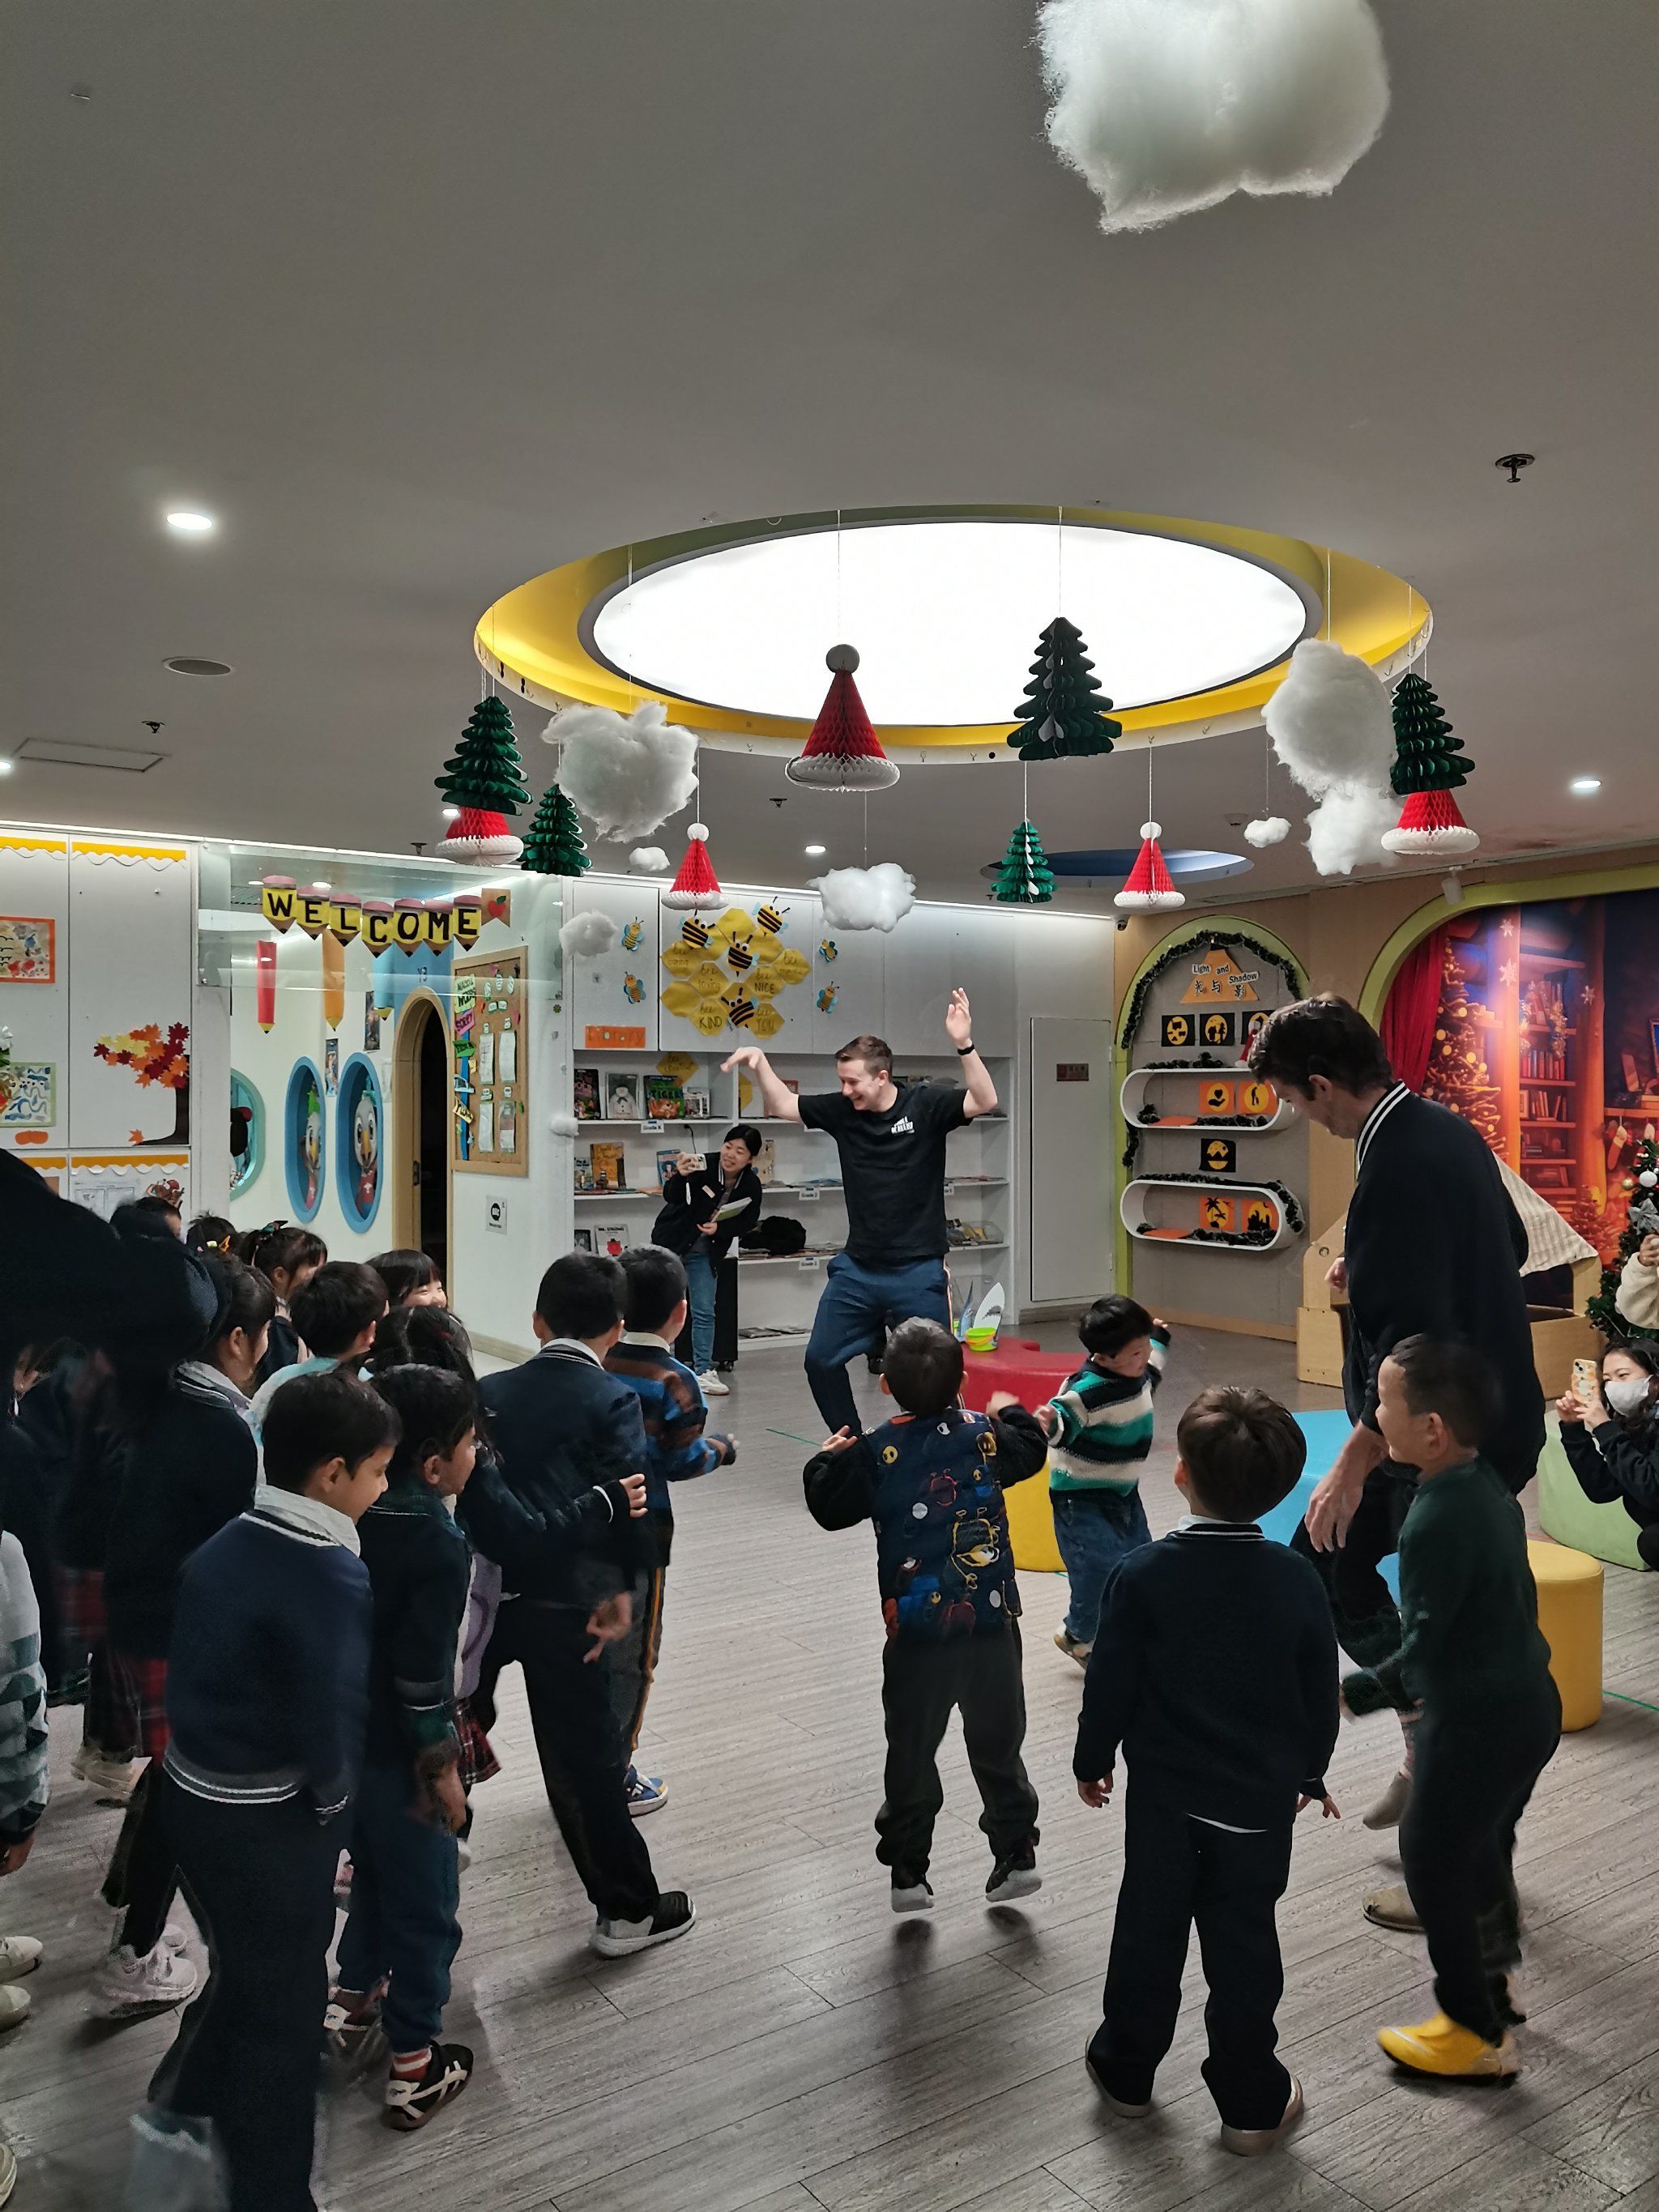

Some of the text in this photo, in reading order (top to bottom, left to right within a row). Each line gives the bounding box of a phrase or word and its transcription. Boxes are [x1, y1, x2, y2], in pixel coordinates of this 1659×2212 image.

[267, 893, 478, 943] WELCOME
[1193, 964, 1257, 984] Light and Shadow
[754, 982, 775, 995] NICE
[699, 1016, 723, 1029] KIND
[586, 1025, 646, 1046] Library
